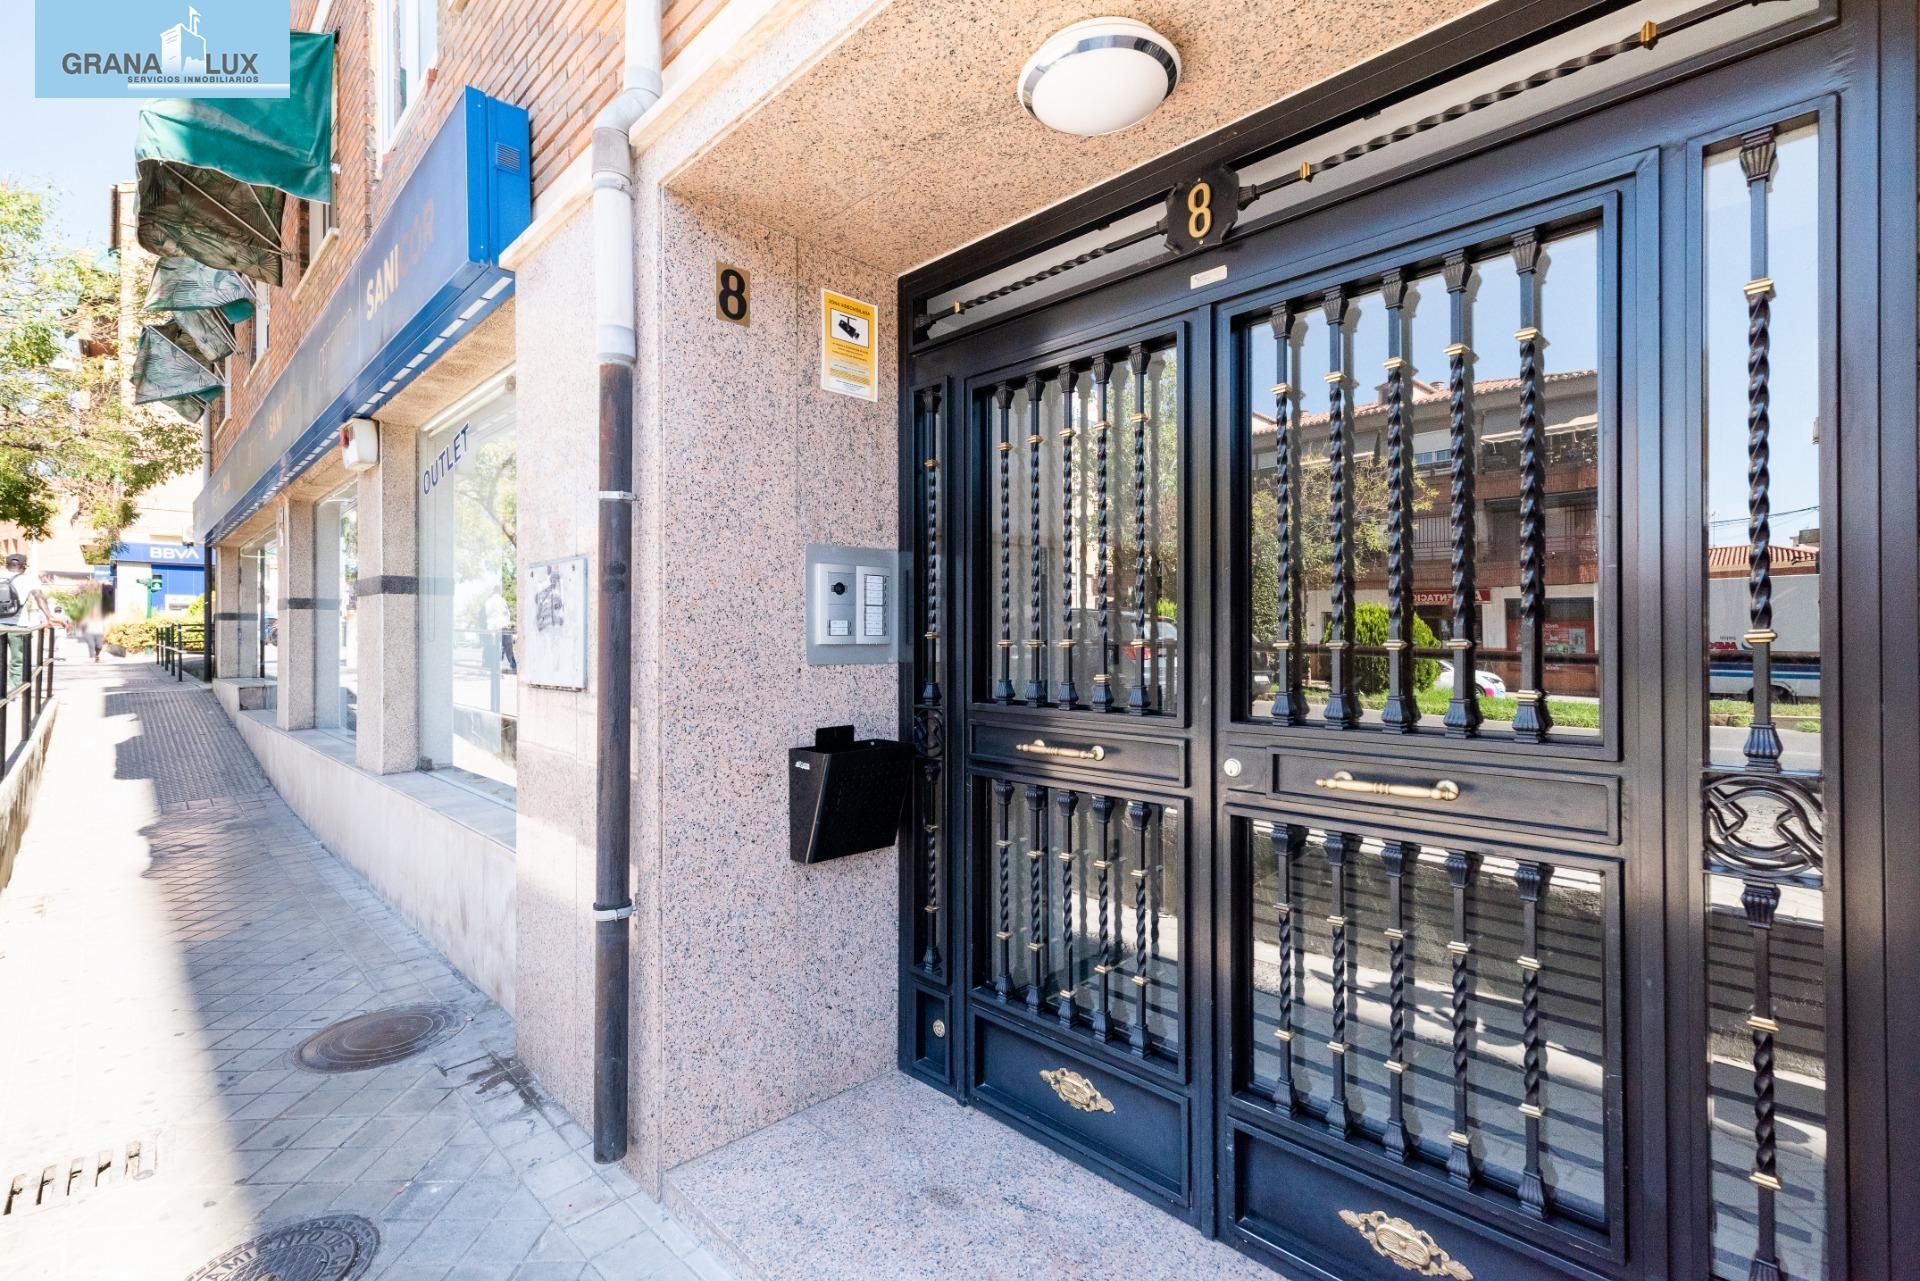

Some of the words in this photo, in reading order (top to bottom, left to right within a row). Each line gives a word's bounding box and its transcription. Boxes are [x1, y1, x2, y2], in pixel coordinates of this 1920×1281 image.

[1187, 182, 1213, 239] 8
[718, 269, 747, 321] 8
[422, 423, 470, 495] OUTLET
[149, 547, 199, 559] BBVA
